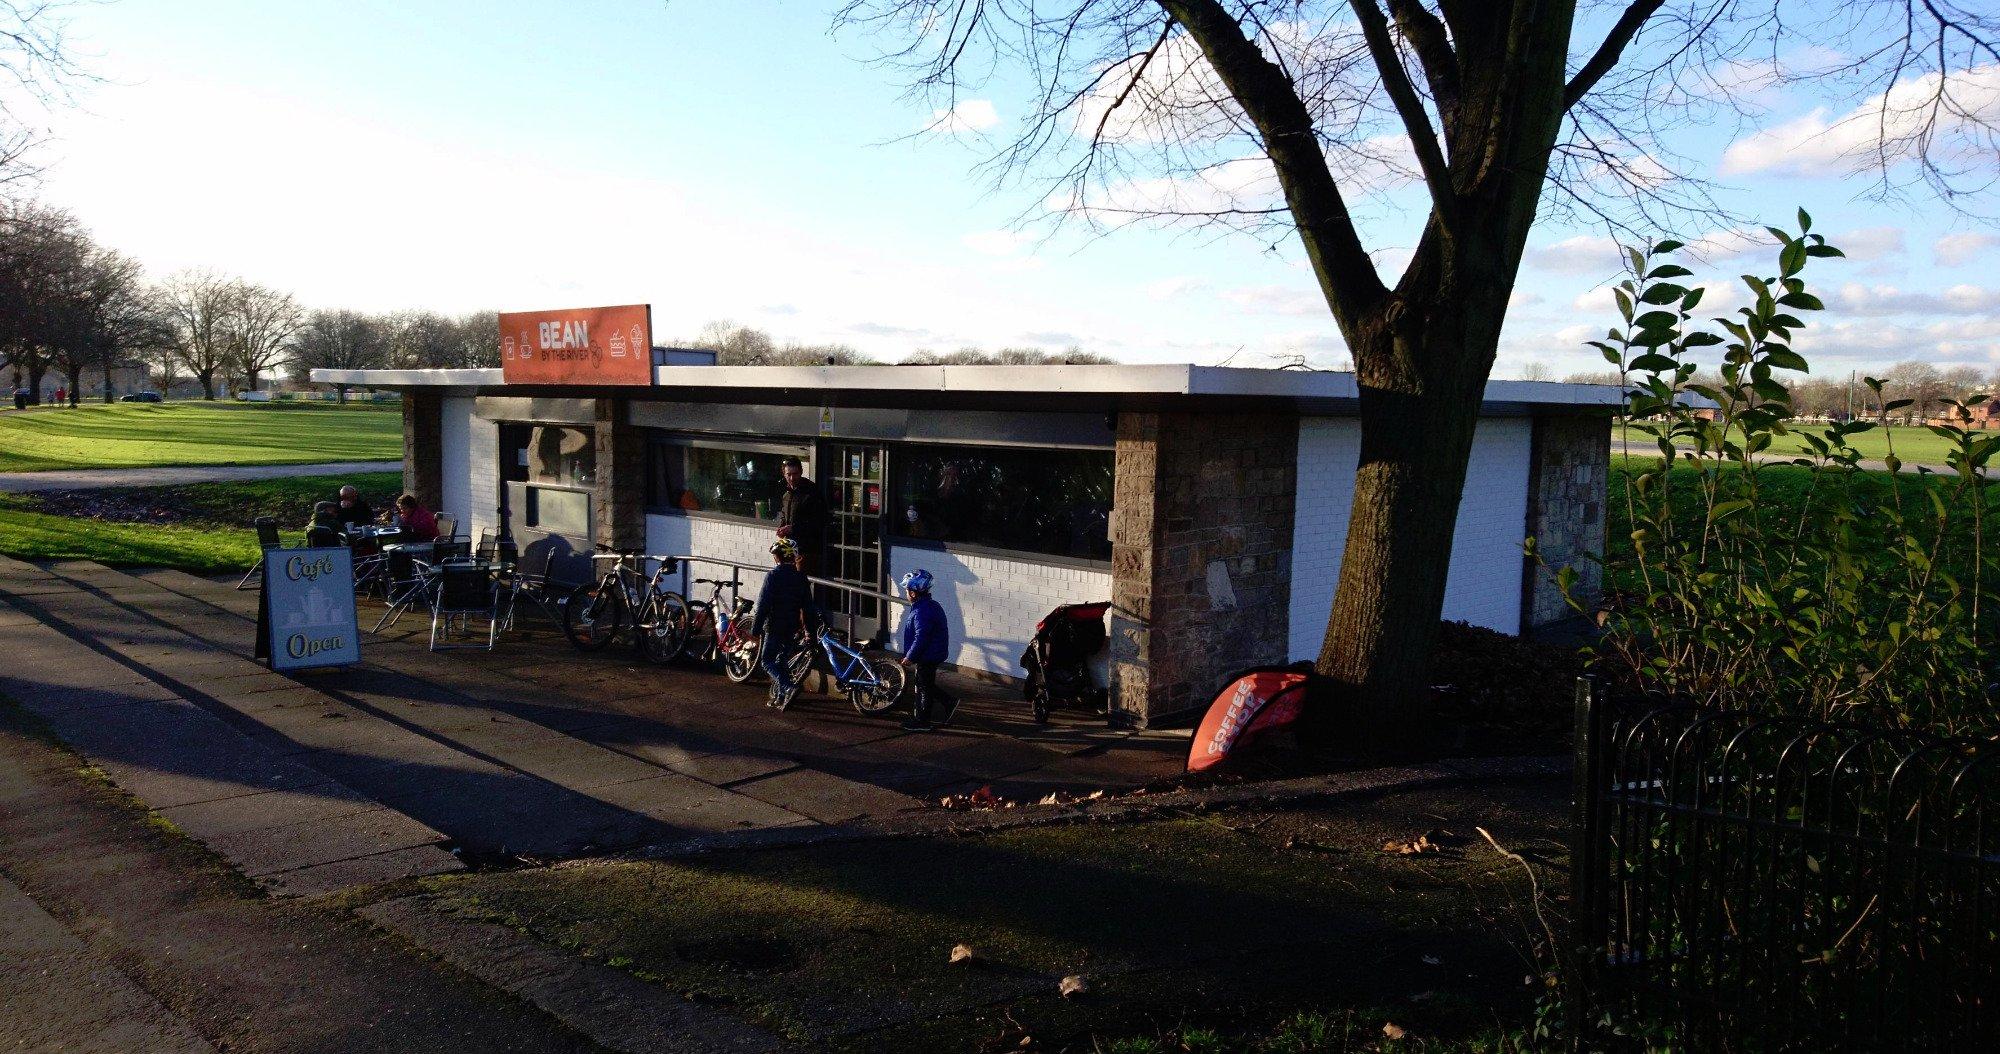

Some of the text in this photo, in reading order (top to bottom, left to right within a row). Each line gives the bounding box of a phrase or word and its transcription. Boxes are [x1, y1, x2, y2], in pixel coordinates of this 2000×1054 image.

[539, 320, 588, 349] BEAN
[541, 349, 588, 361] BY THE RIVER
[286, 555, 334, 581] Café
[287, 633, 344, 659] Open
[1207, 680, 1252, 755] COFFEE
